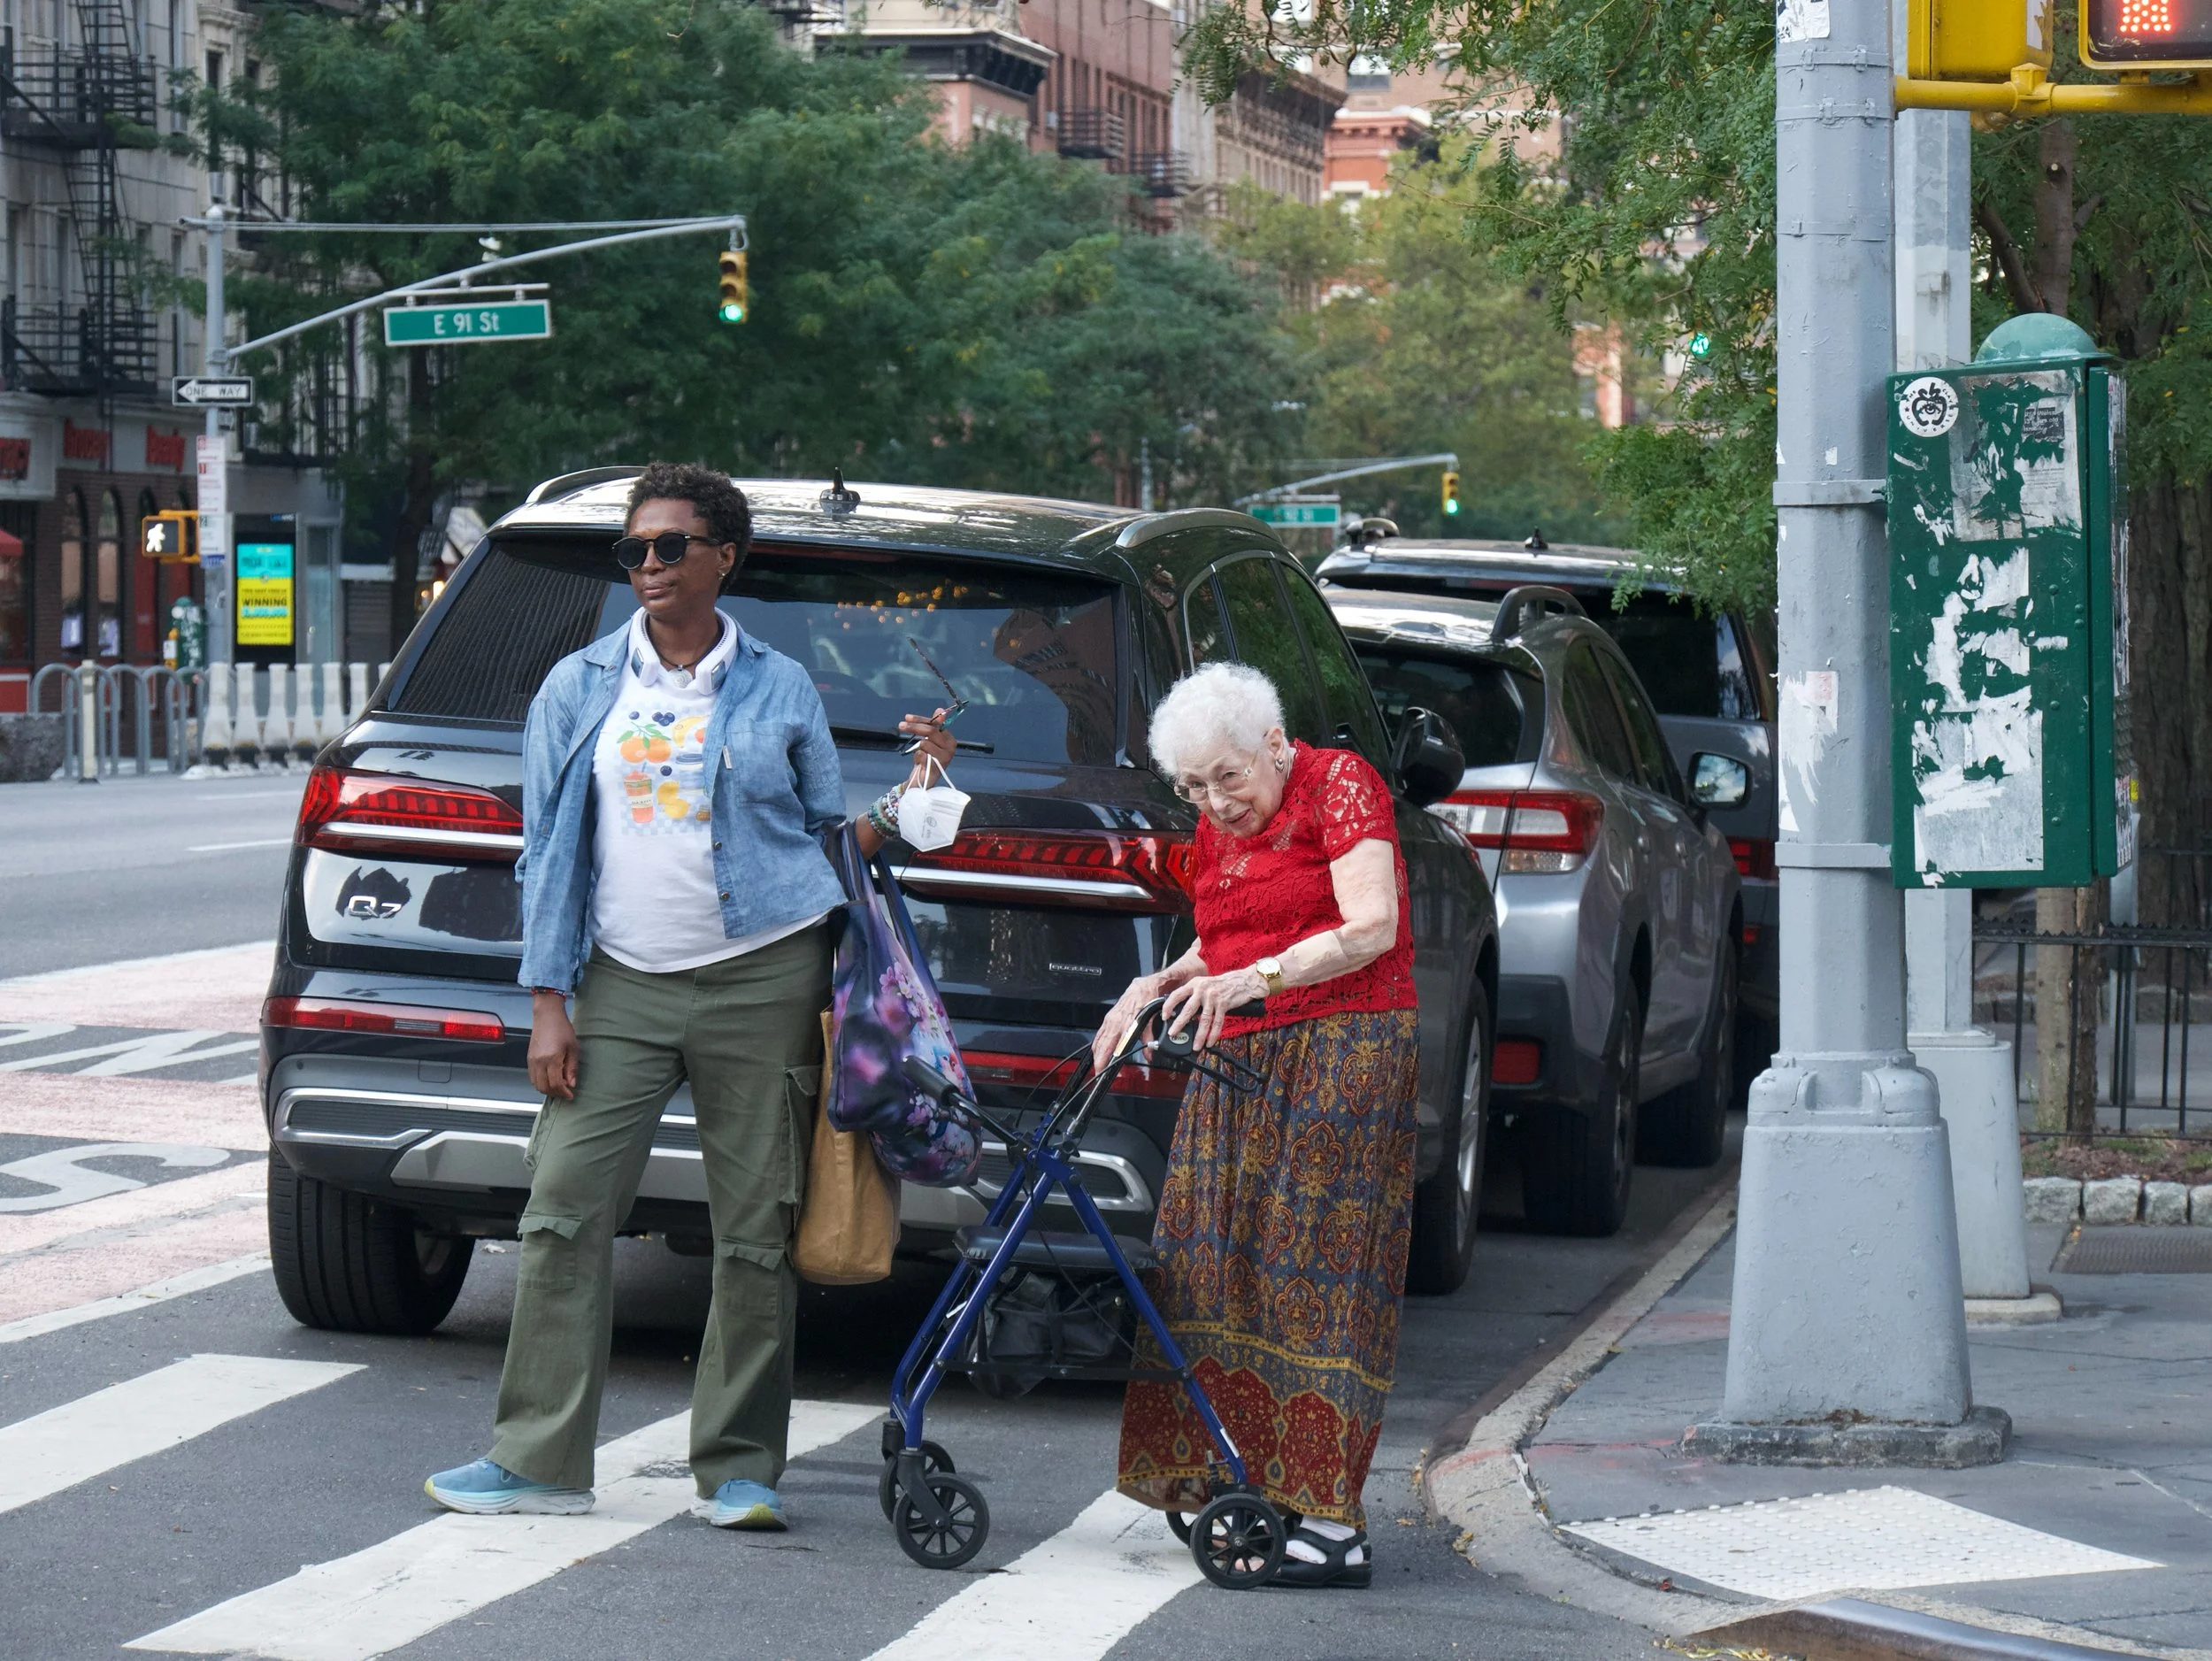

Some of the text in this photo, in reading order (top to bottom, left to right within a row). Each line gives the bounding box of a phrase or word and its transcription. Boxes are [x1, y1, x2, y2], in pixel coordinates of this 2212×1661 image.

[434, 311, 500, 335] E 91 St
[186, 386, 241, 396] ONE WAY
[348, 895, 402, 919] Q7
[1051, 965, 1100, 973] quattro
